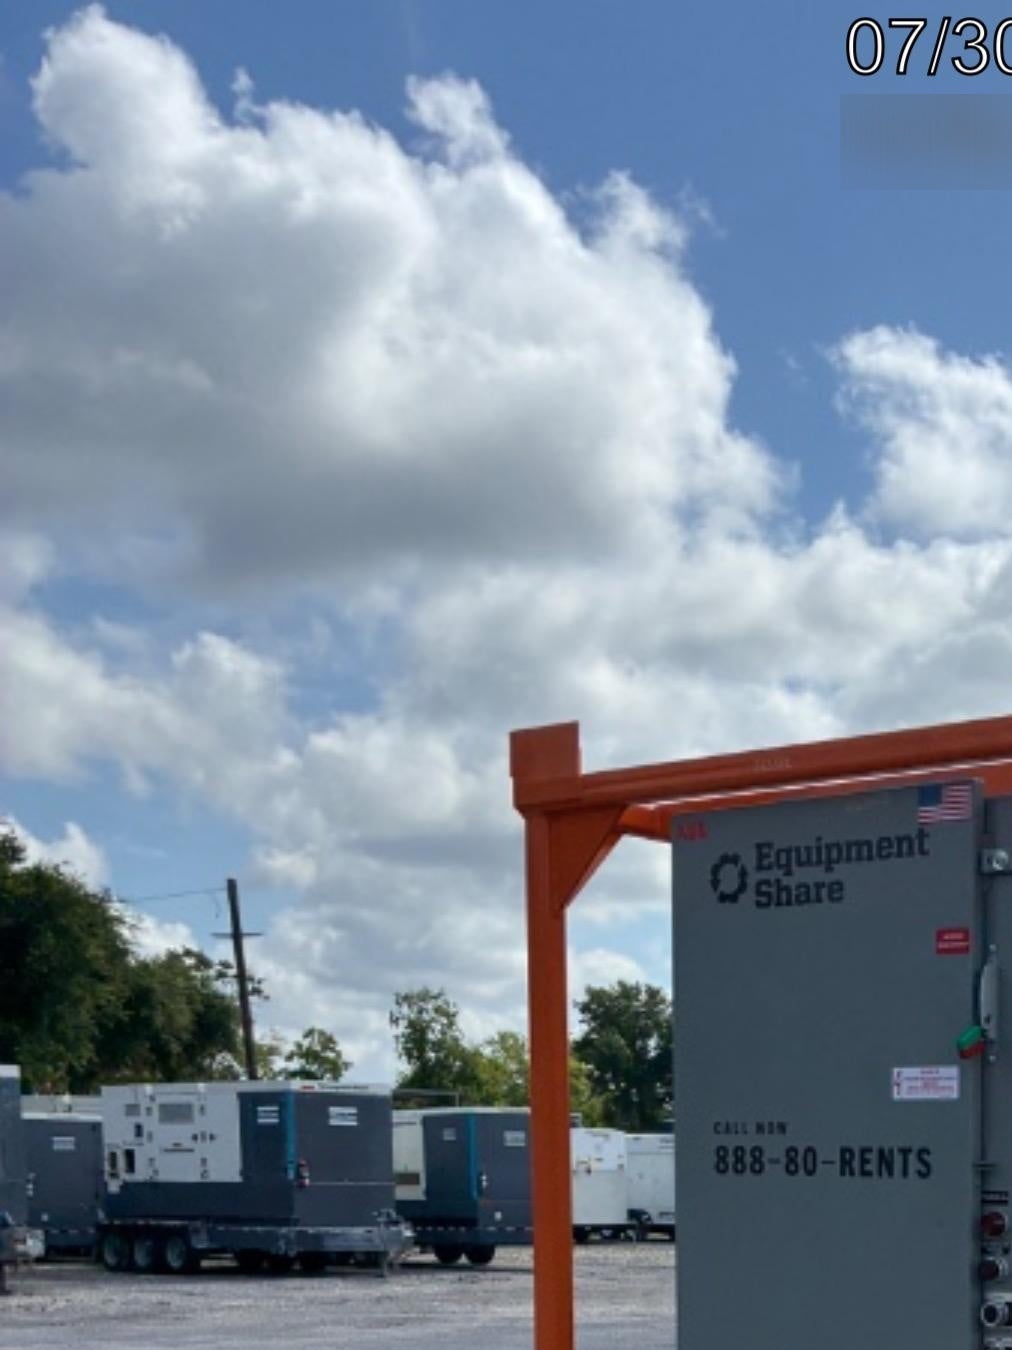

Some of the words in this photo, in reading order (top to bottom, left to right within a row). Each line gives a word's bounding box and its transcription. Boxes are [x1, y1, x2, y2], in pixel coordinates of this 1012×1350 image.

[754, 827, 931, 876] Equipment
[754, 878, 845, 909] Share
[713, 1121, 749, 1135] CALL
[755, 1121, 788, 1135] NOW
[714, 1145, 933, 1180] 888-80-RENTS
